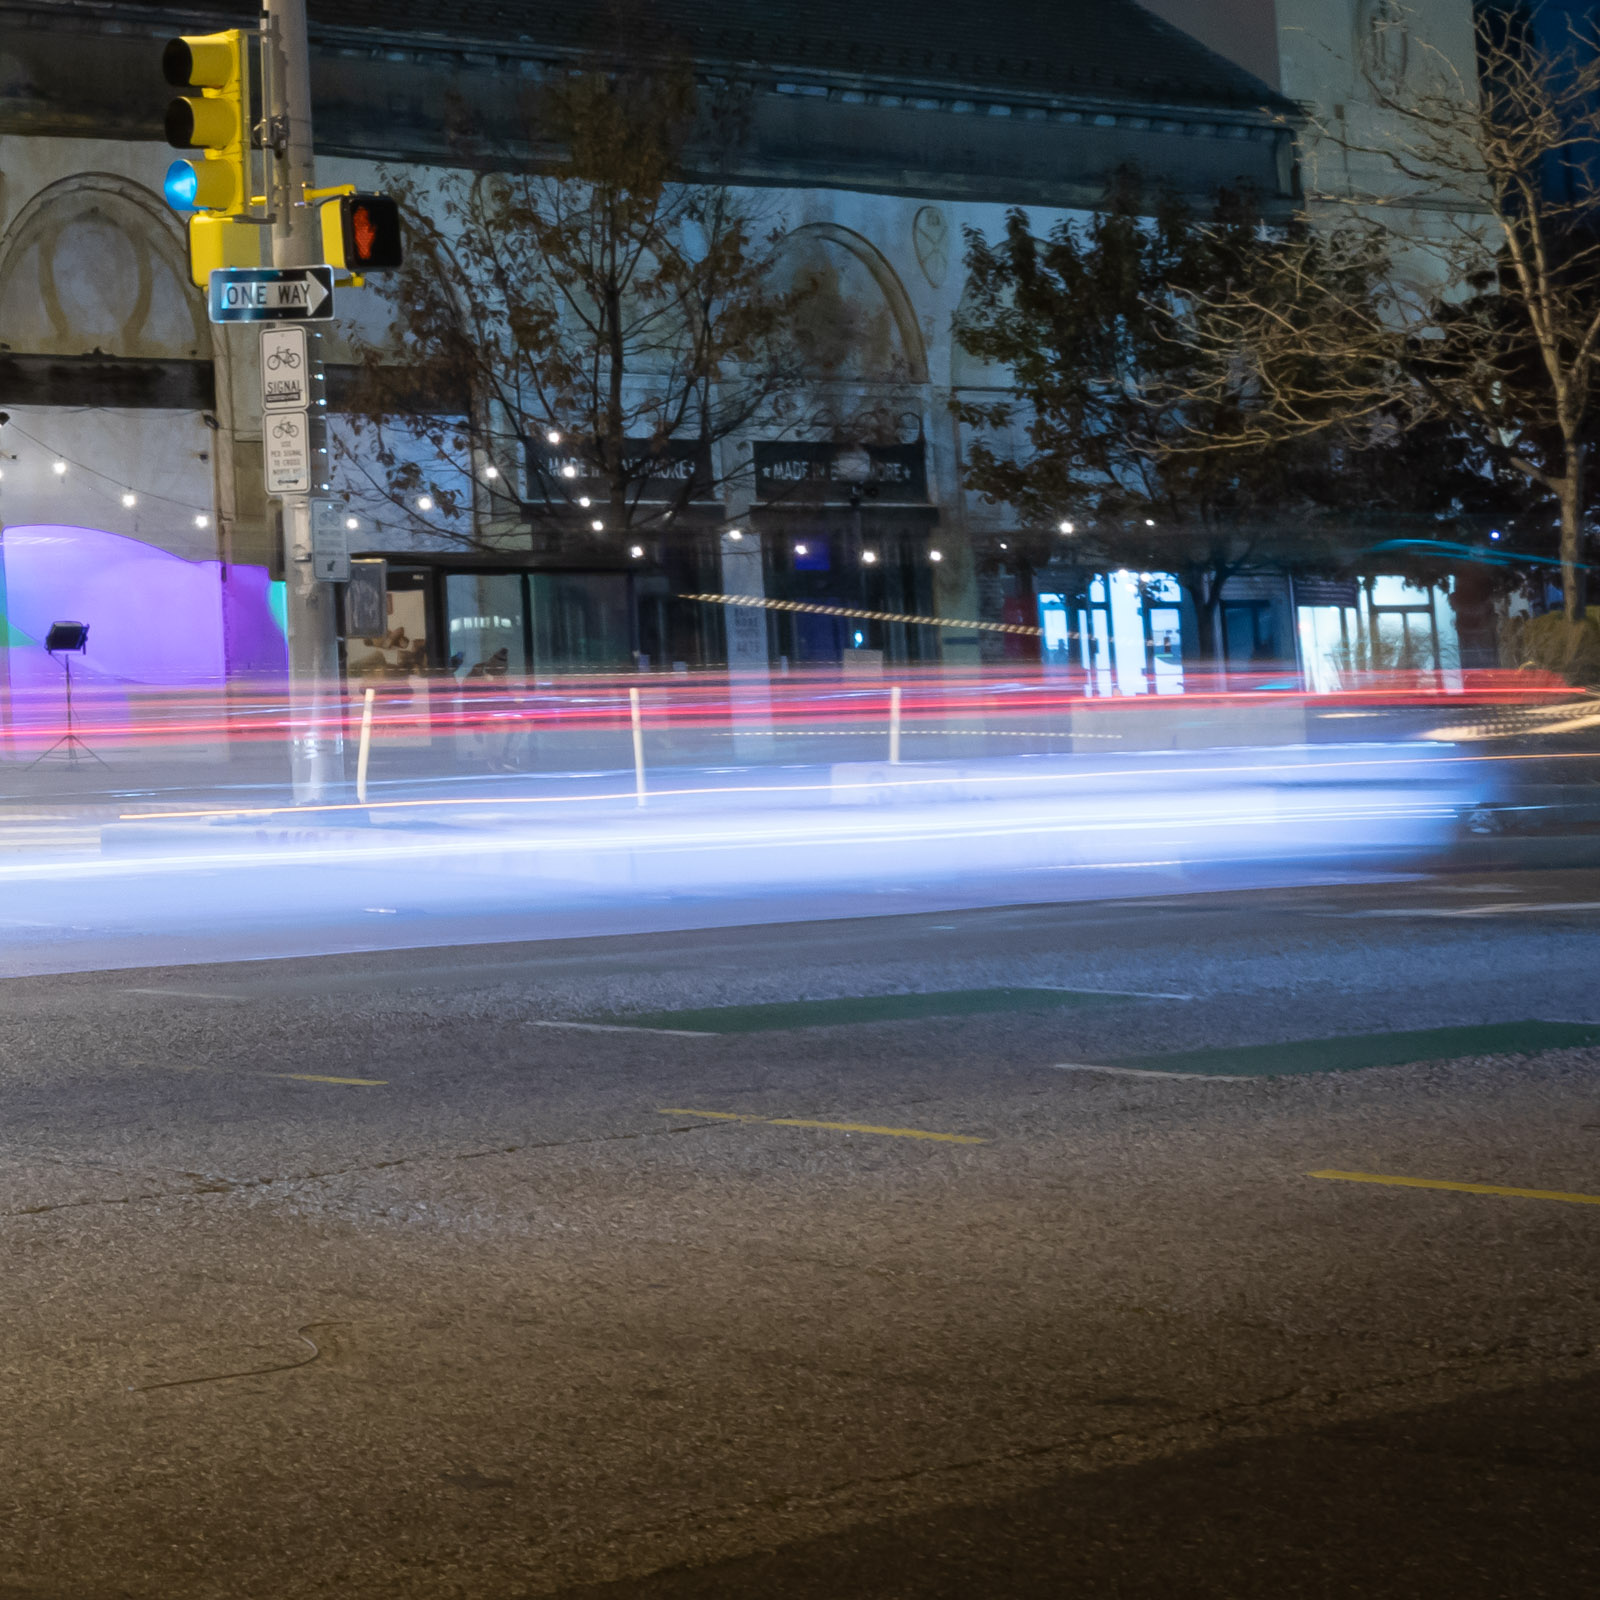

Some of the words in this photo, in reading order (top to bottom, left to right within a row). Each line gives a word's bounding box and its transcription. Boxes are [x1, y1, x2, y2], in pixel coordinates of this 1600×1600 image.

[226, 285, 267, 306] ONE
[278, 283, 310, 305] WAY
[267, 380, 303, 395] SIGNAL
[773, 460, 808, 481] MADE
